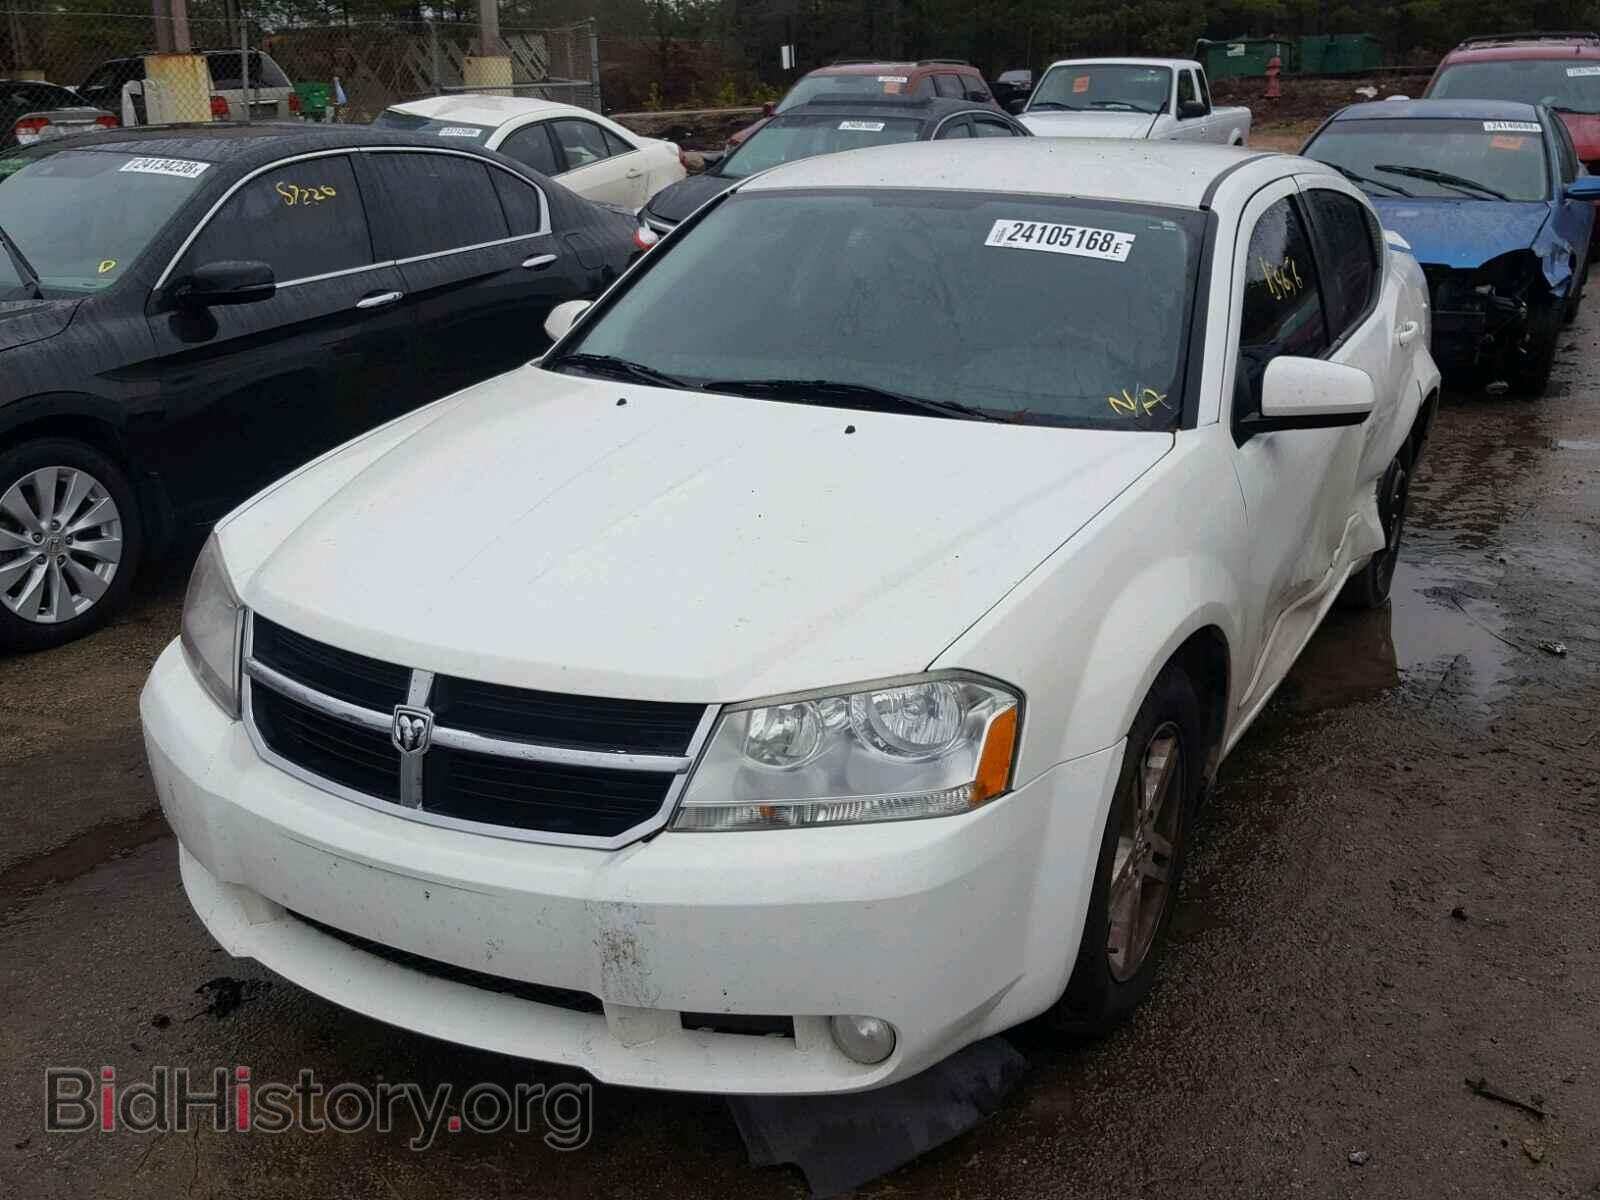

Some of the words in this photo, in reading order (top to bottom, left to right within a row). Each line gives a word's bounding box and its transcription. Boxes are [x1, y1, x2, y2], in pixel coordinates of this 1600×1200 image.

[1006, 222, 1115, 253] 24105168
[1113, 242, 1124, 255] E
[1108, 383, 1172, 418] N/A
